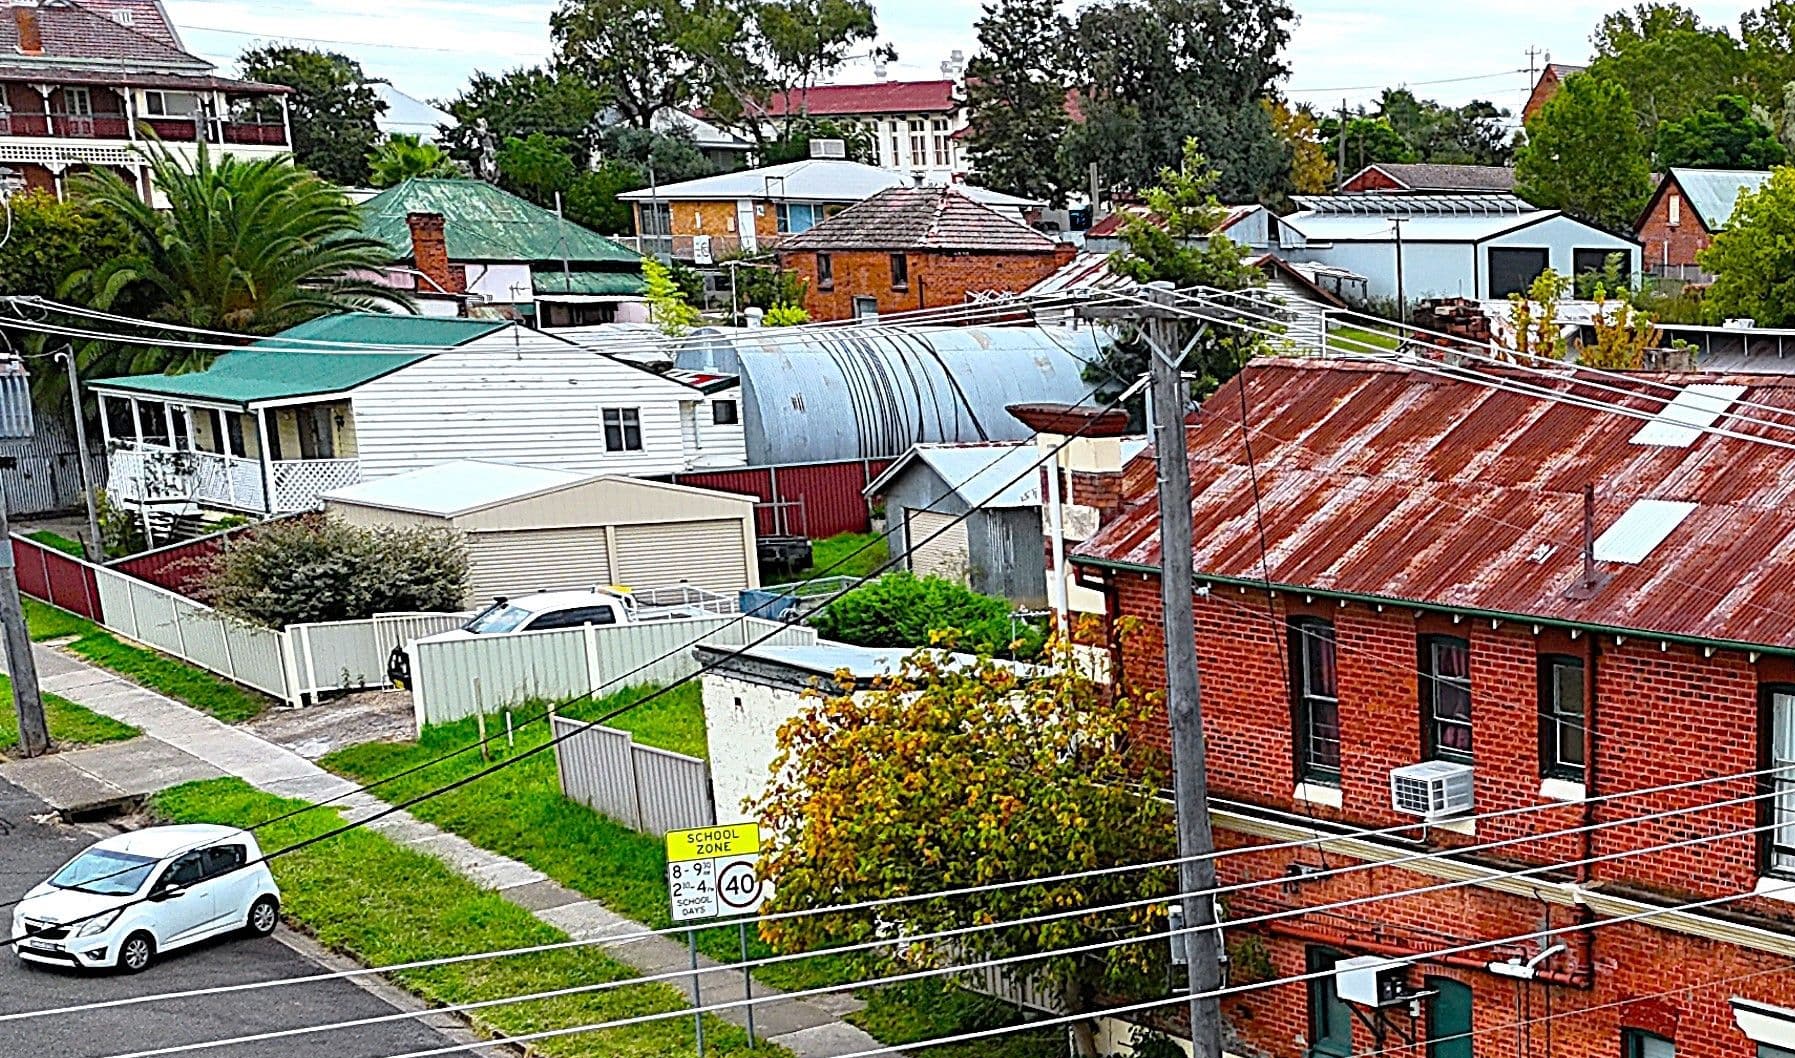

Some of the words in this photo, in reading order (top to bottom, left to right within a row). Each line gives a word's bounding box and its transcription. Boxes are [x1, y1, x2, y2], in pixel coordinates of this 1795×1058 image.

[687, 829, 740, 844] SCHOOL
[696, 841, 732, 855] ZONE
[725, 873, 755, 896] 40
[676, 896, 713, 907] SCHOOL
[682, 905, 706, 916] DAYS
